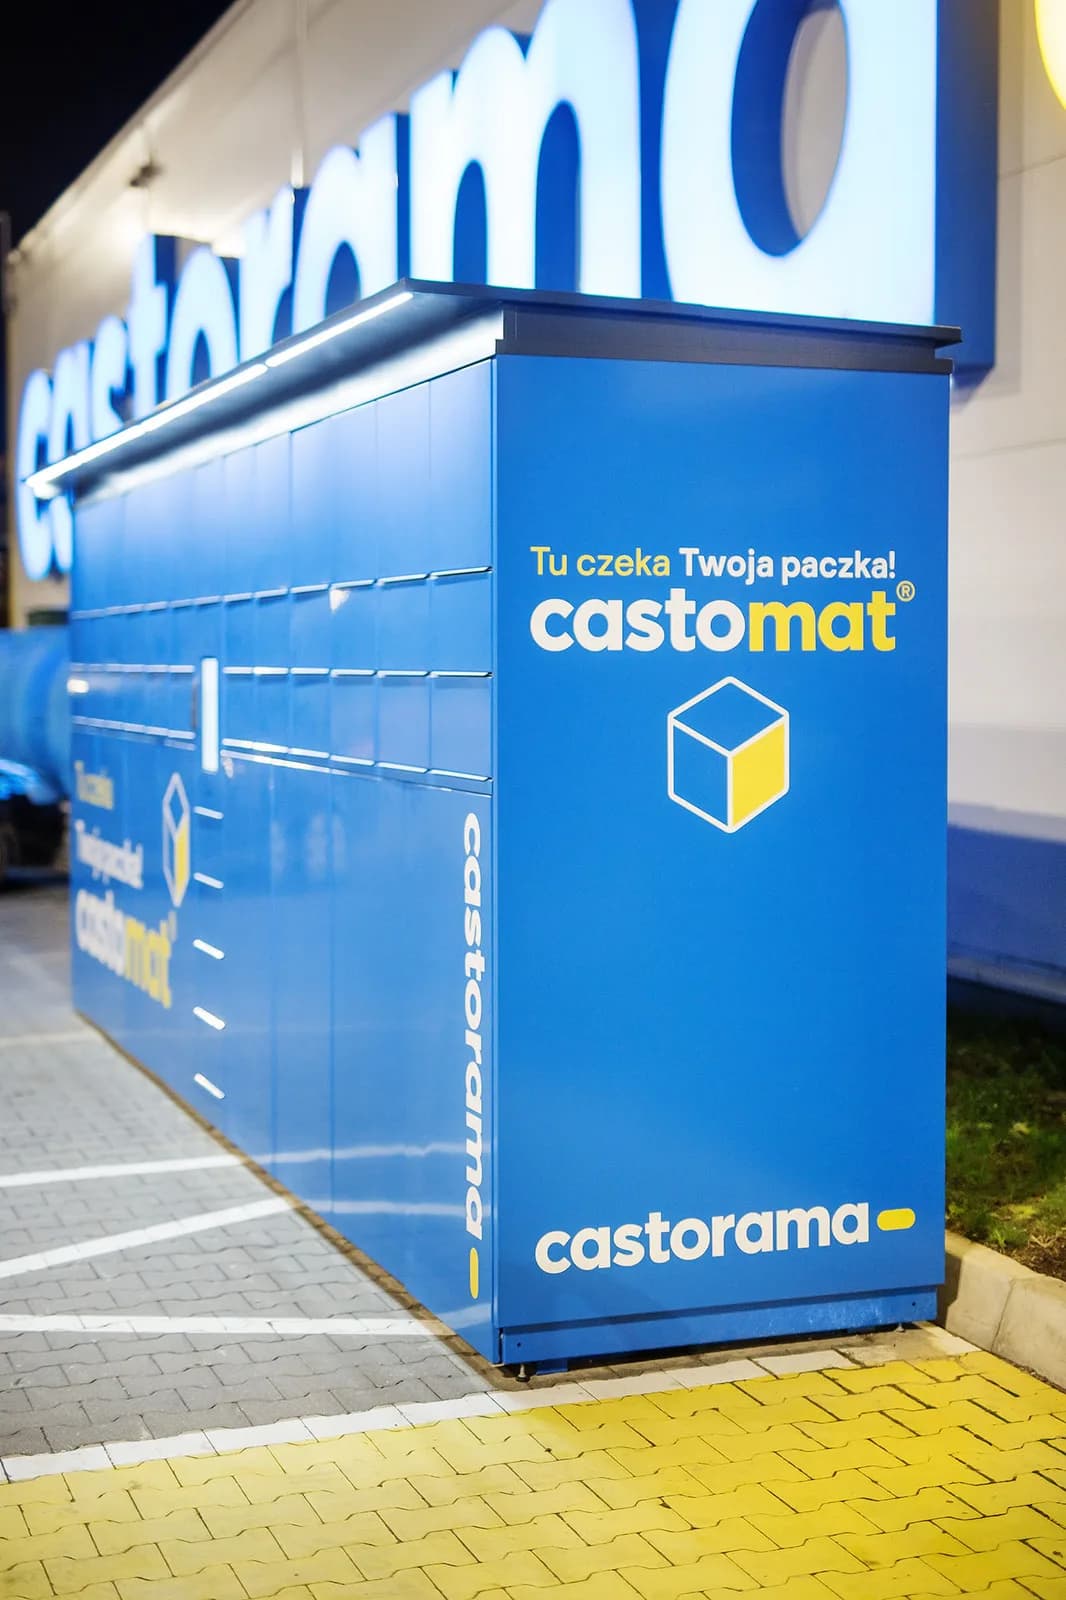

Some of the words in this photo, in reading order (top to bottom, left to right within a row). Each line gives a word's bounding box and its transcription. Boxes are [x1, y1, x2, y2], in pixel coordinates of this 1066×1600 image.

[530, 546, 567, 576] Tu
[576, 548, 671, 577] czeka
[679, 547, 774, 586] Twoja
[781, 550, 896, 586] paczka!
[463, 812, 486, 1241] castorama
[535, 1202, 870, 1274] castorama
